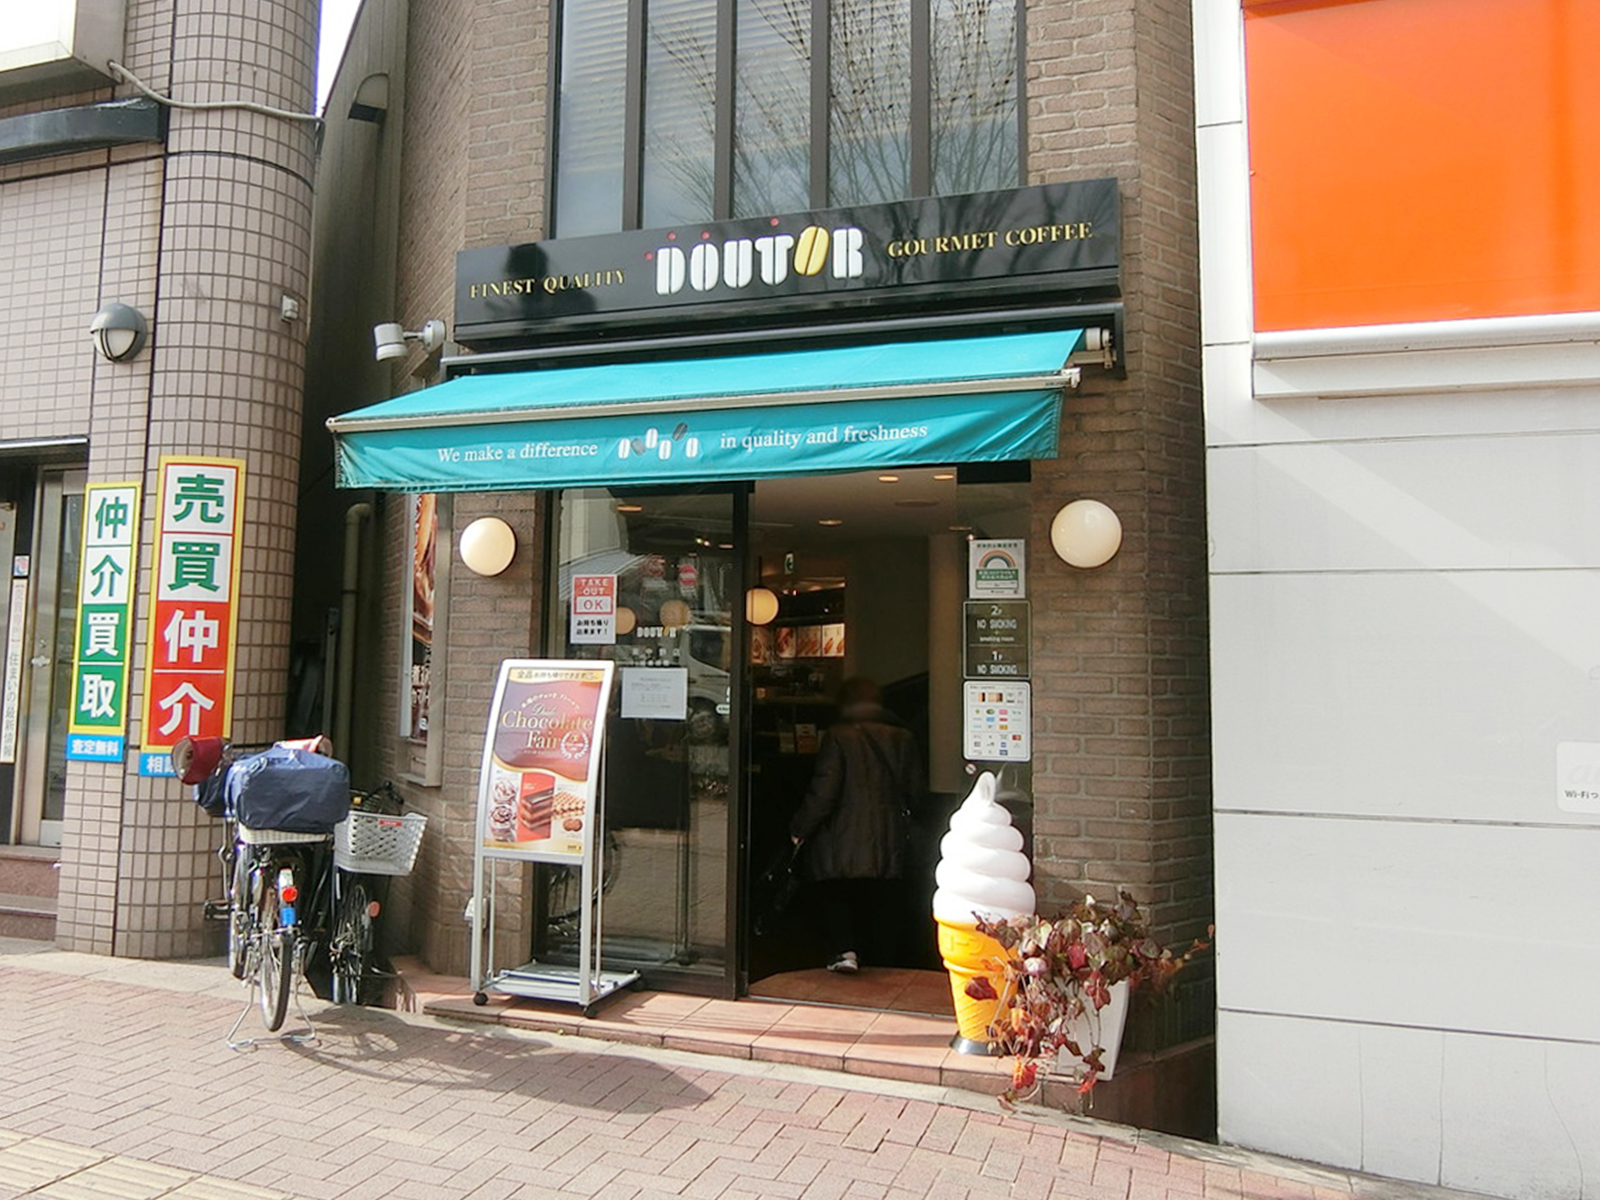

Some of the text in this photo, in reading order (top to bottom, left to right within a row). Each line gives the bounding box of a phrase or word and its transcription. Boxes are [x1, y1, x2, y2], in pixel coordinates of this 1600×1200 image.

[887, 221, 1094, 258] GOURMET COFFEE
[656, 226, 864, 295] DOUTOR
[470, 268, 626, 299] FINEST QUALITY
[720, 424, 929, 452] in quality and freshness
[437, 442, 598, 462] We make a difference
[579, 578, 609, 587] TAKE
[583, 587, 605, 596] OUT
[80, 496, 128, 719] 仲介買取
[158, 473, 225, 737] 売買仲介
[583, 599, 604, 611] OK
[501, 710, 593, 730] Chocolate
[526, 731, 560, 749] Fair
